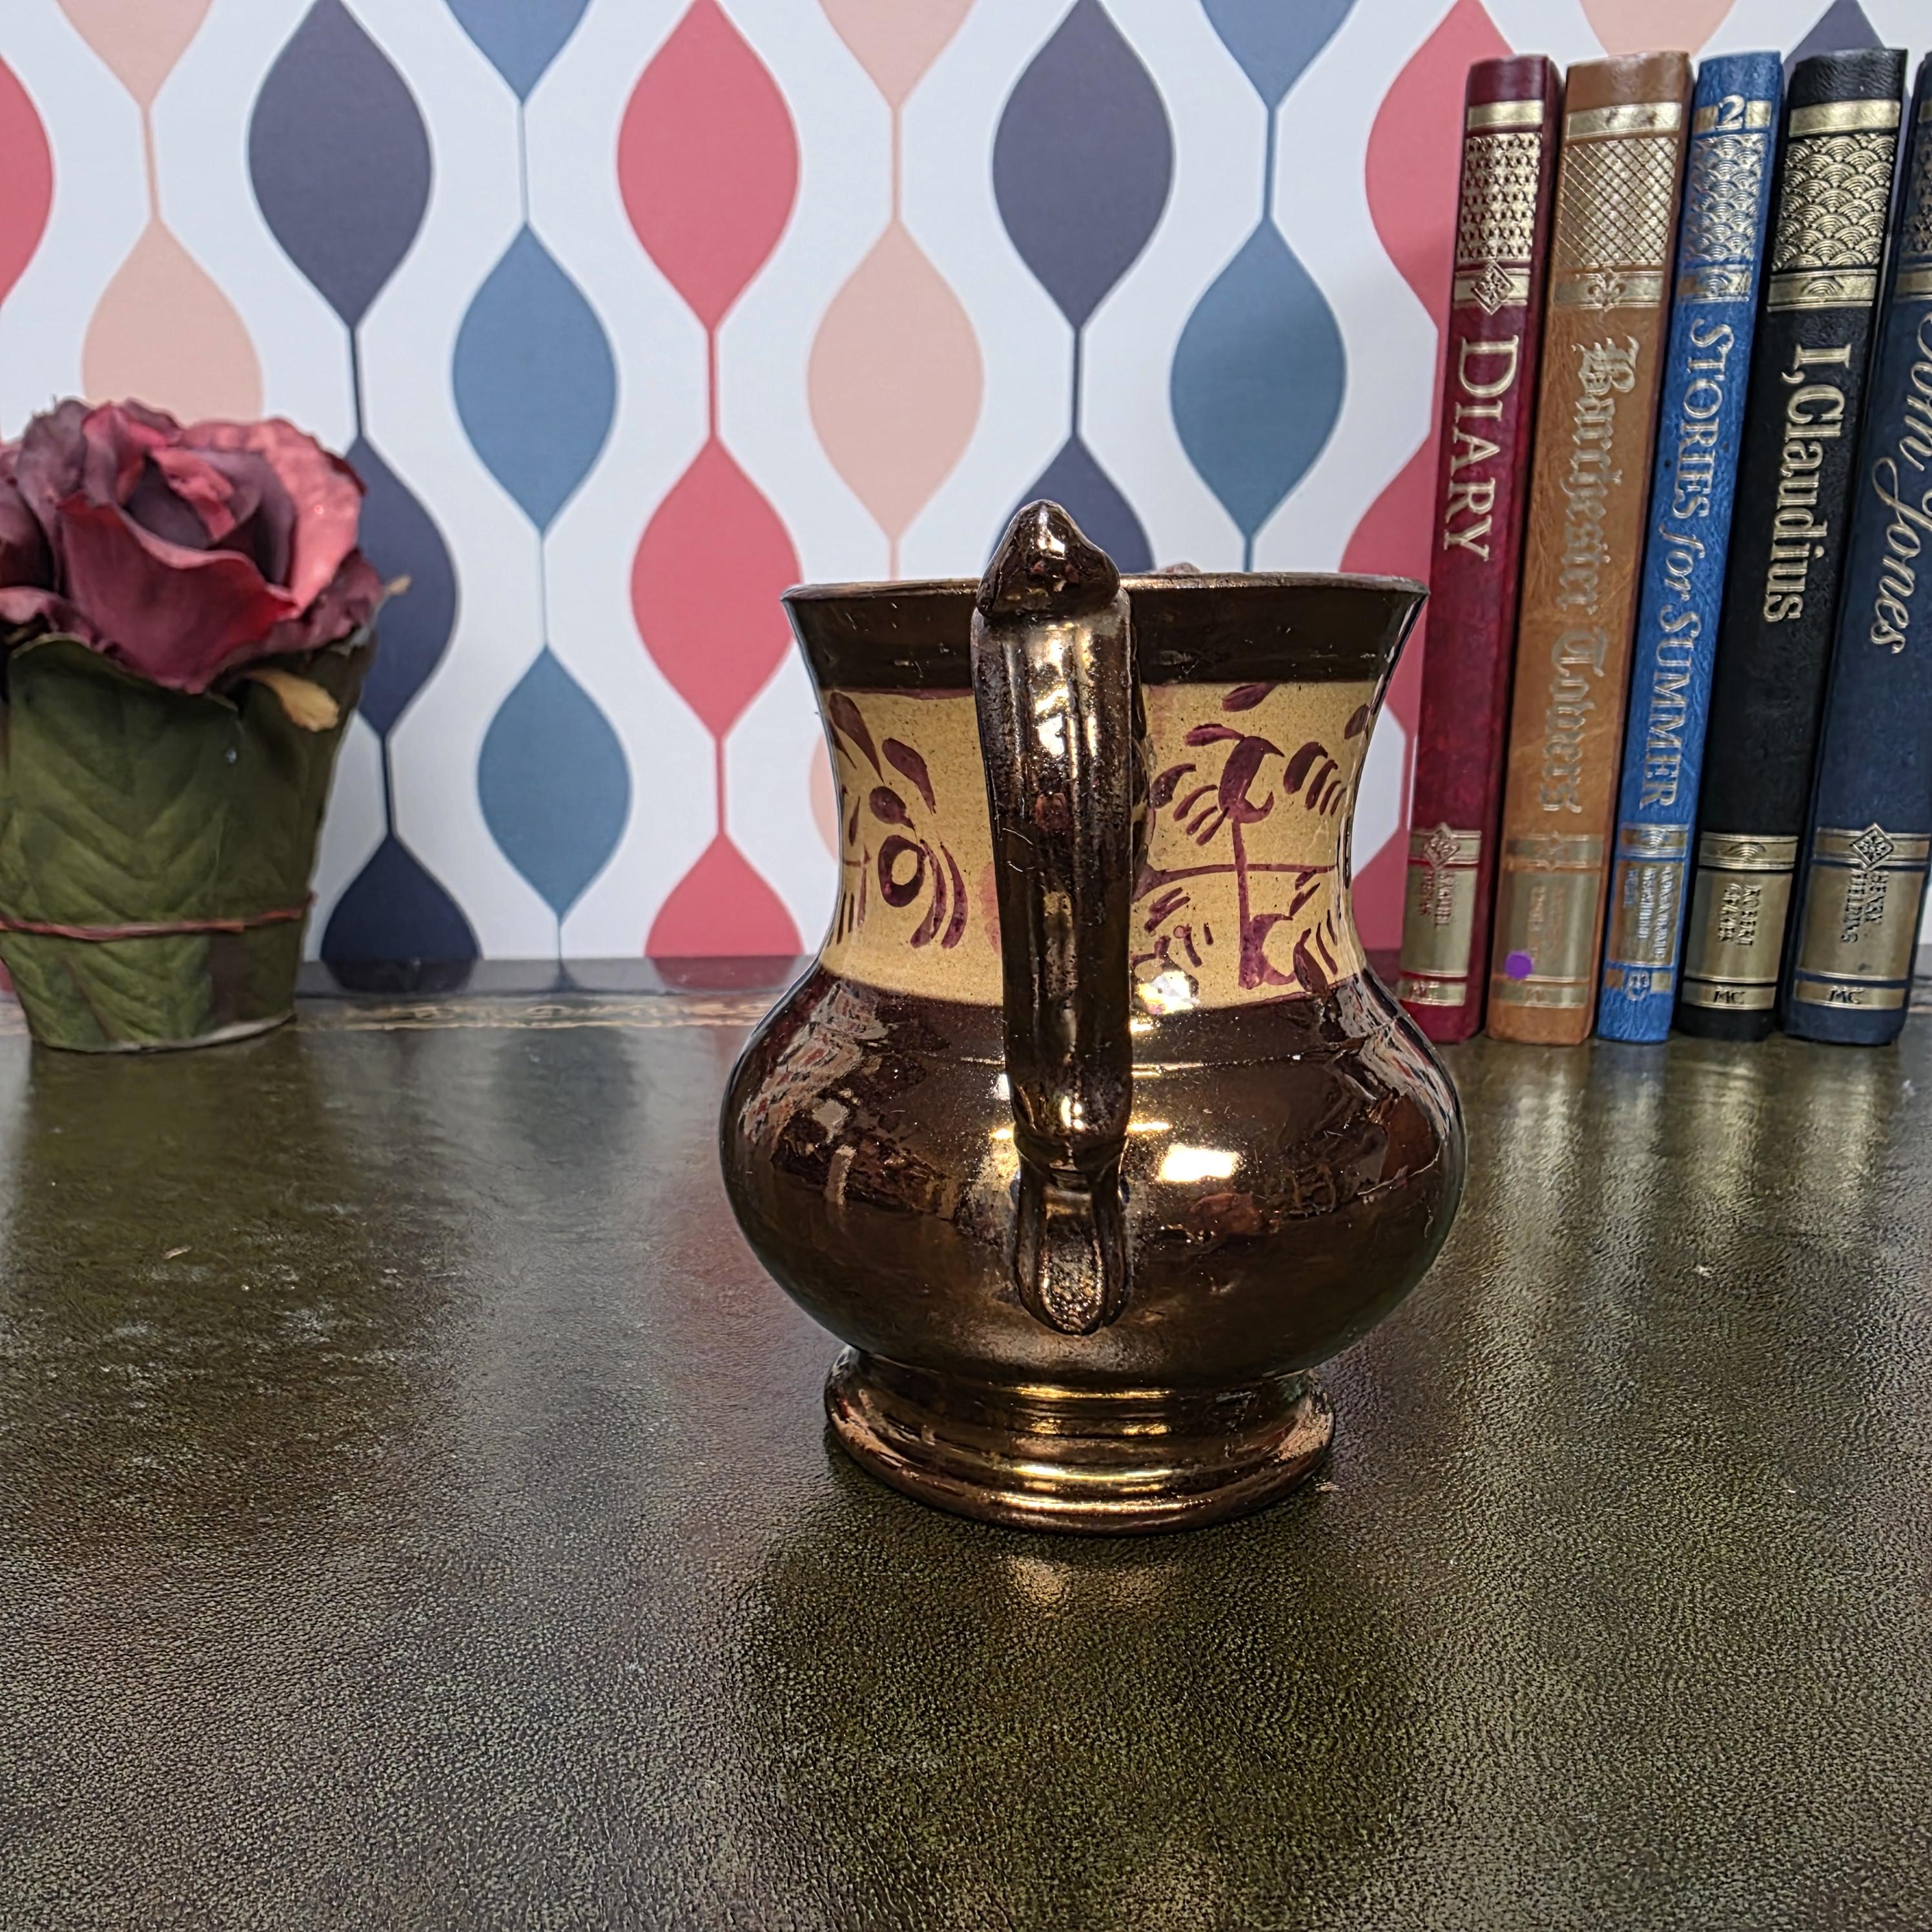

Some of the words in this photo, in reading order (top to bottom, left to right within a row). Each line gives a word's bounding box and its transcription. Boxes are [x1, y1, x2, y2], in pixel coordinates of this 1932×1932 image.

[1715, 94, 1745, 130] 2
[1444, 334, 1519, 561] DIARY
[1556, 333, 1639, 615] Barchester
[1672, 318, 1734, 519] STORIES
[1658, 523, 1705, 601] for
[1539, 626, 1608, 813] Towers
[1639, 604, 1701, 810] SUMMER
